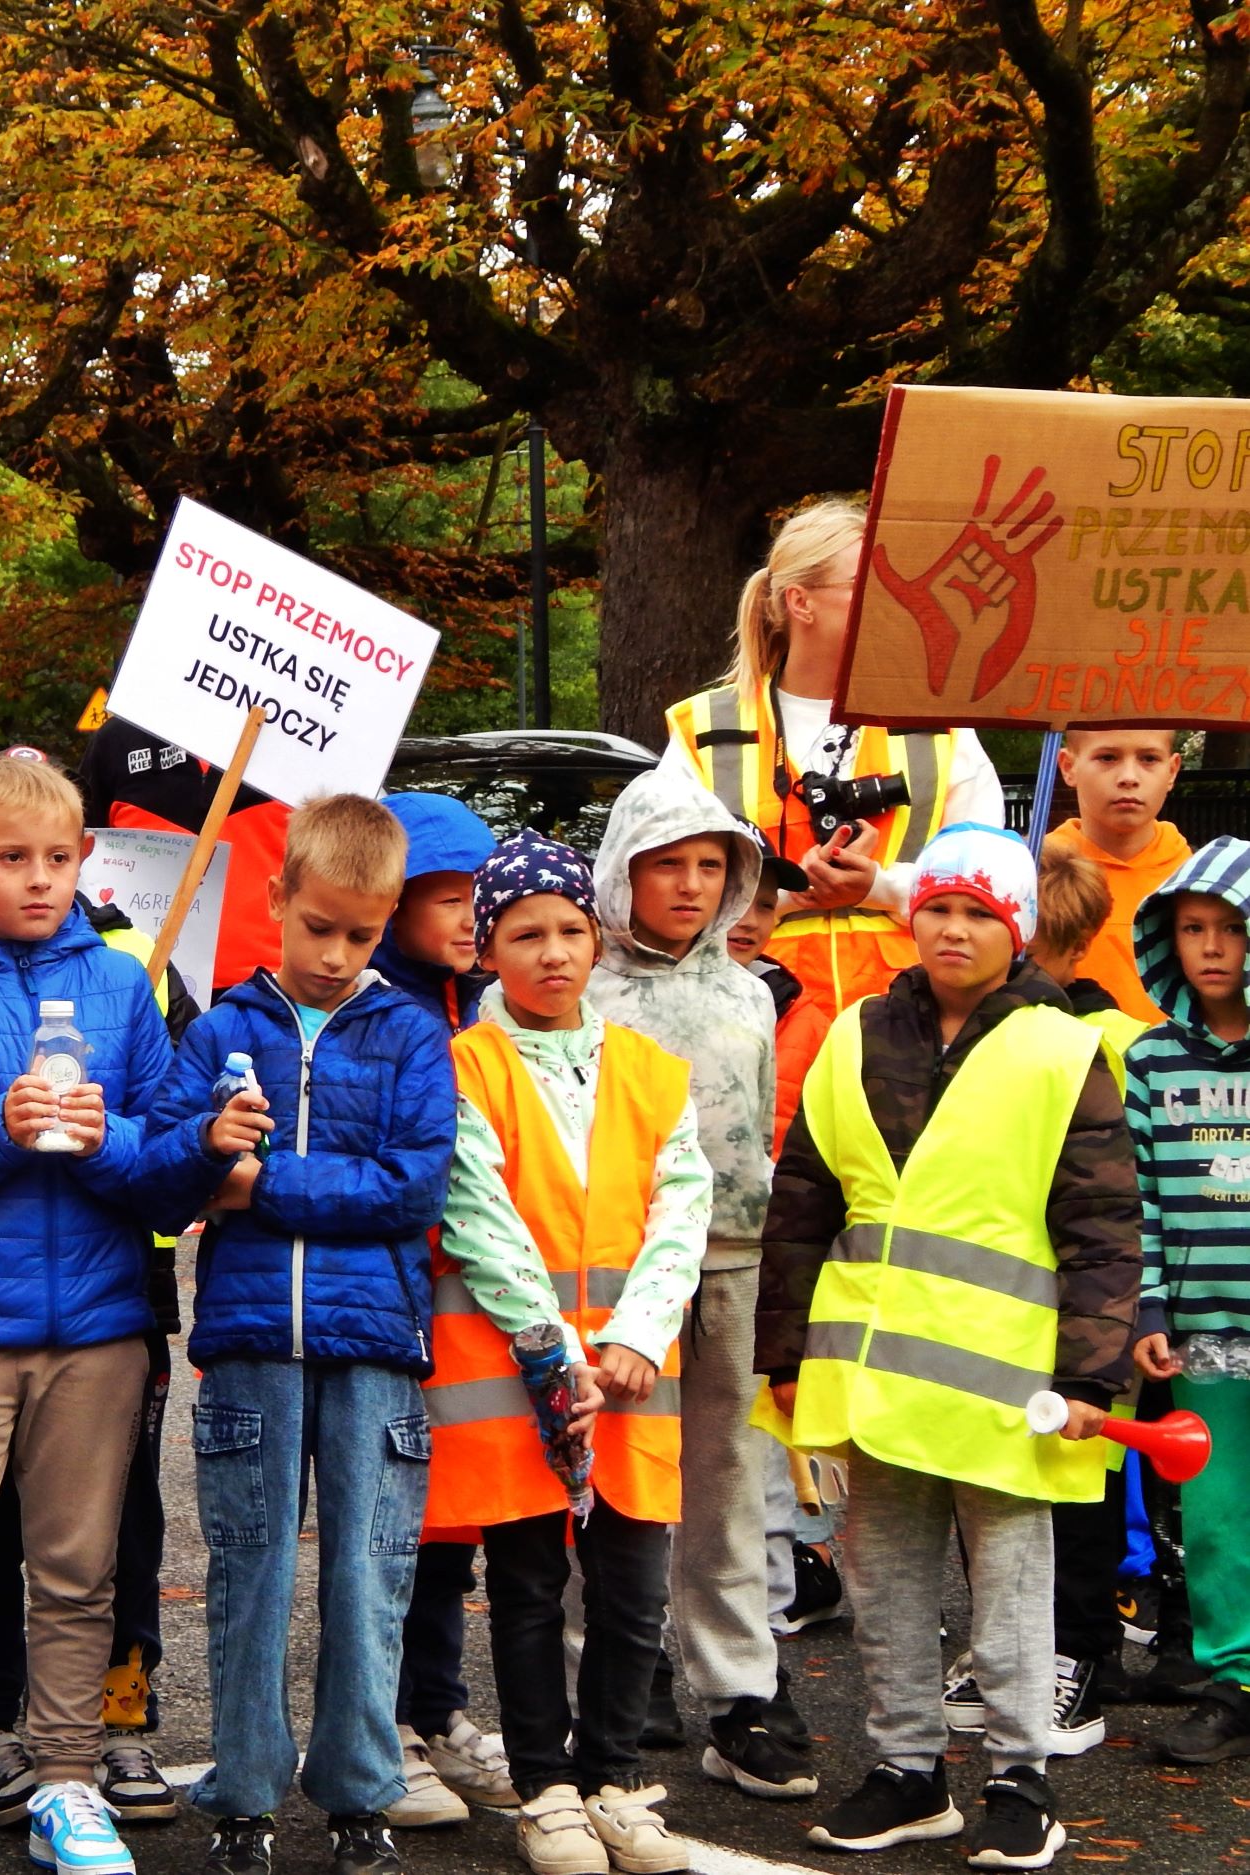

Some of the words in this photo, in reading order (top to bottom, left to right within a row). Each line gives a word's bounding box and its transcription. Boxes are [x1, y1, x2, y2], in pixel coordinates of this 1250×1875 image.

[175, 542, 253, 594] STOP
[255, 583, 414, 682] PRZEMOCY
[184, 659, 338, 753] JEDNOCZY
[208, 613, 298, 682] USTKA
[304, 665, 351, 713] SIĘ
[129, 892, 201, 915] AGREA
